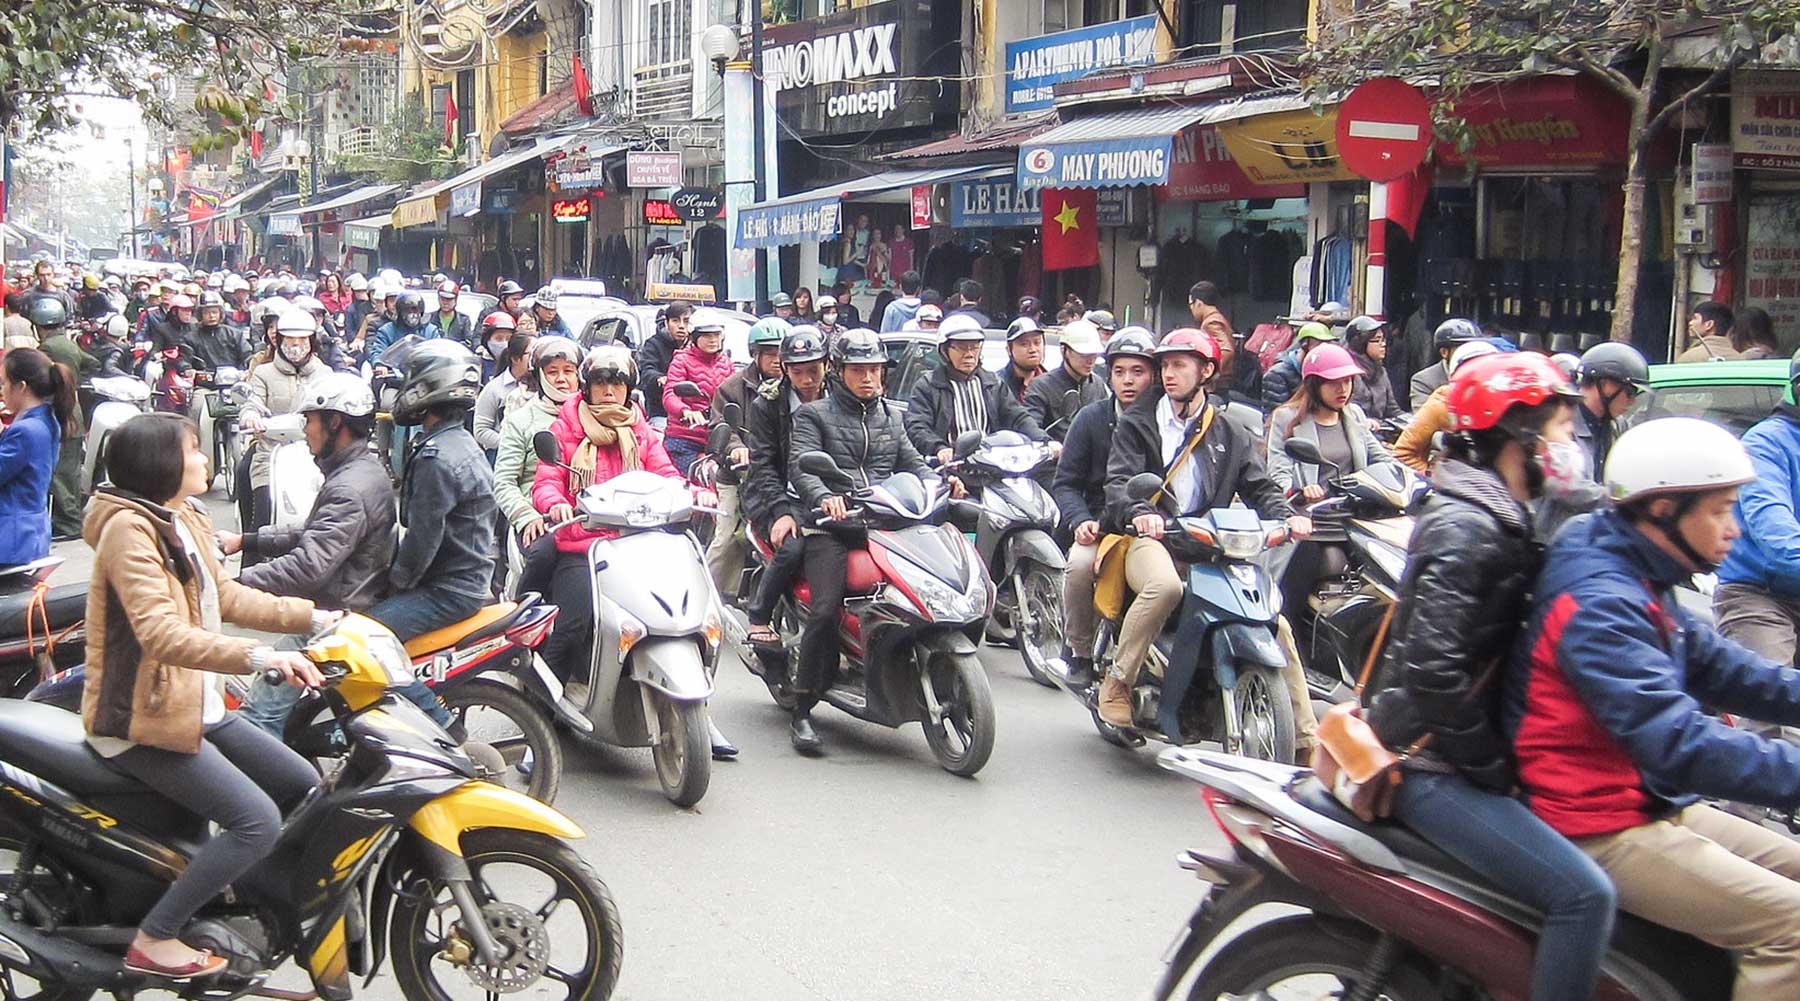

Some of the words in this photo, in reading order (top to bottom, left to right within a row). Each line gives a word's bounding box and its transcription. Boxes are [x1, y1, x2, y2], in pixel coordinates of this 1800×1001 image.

[1096, 33, 1121, 68] FOR
[827, 82, 895, 119] concept
[1033, 151, 1045, 169] 6
[1062, 153, 1095, 182] MAY
[1098, 148, 1163, 180] PHUONG
[690, 209, 704, 217] 12
[41, 816, 88, 848] YAMAHA
